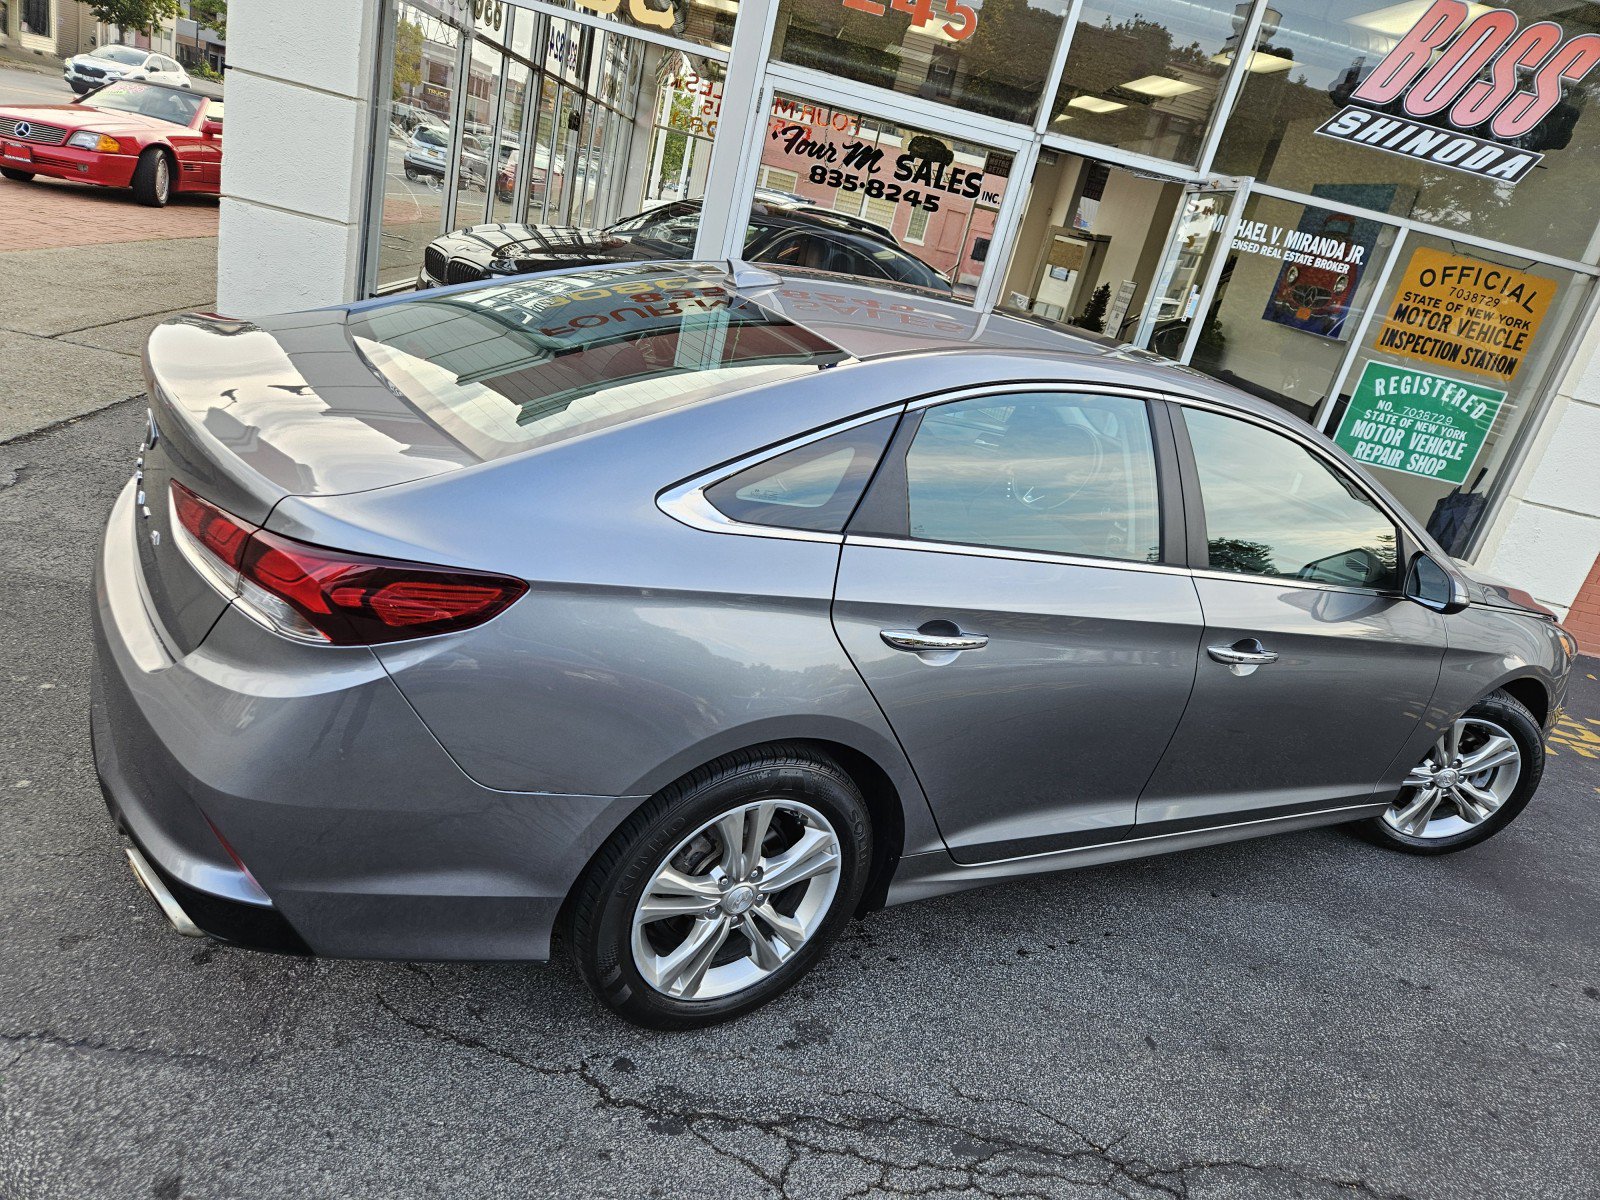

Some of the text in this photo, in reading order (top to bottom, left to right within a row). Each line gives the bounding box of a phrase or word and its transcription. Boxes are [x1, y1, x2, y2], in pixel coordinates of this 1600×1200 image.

[842, 0, 977, 41] 45
[1350, 0, 1600, 138] BOSS
[772, 126, 837, 164] Four
[842, 141, 884, 174] M
[893, 154, 983, 199] SALES
[982, 190, 1001, 205] INC.
[1327, 110, 1535, 179] SHINODA
[1212, 213, 1365, 266] MIHAEL V. MIRANDA JR.
[1260, 245, 1282, 259] REAL
[1283, 251, 1315, 267] ESTATE
[1313, 257, 1350, 275] BROKER
[1403, 291, 1531, 331] STATE OF NEW YORK
[1419, 266, 1537, 314] OFFICIAL
[1449, 287, 1501, 308] 7038729
[1393, 303, 1528, 352] MOTOR VEHICLE
[1380, 327, 1518, 376] INSPECTION STATION
[1374, 375, 1487, 420] REGISTERED
[1376, 400, 1453, 426] NO. 7038729
[1350, 419, 1468, 461] MOTOR VEHICLE
[1364, 409, 1467, 441] STATE OF NEW YORK
[1352, 440, 1447, 476] REPAIR SHOP
